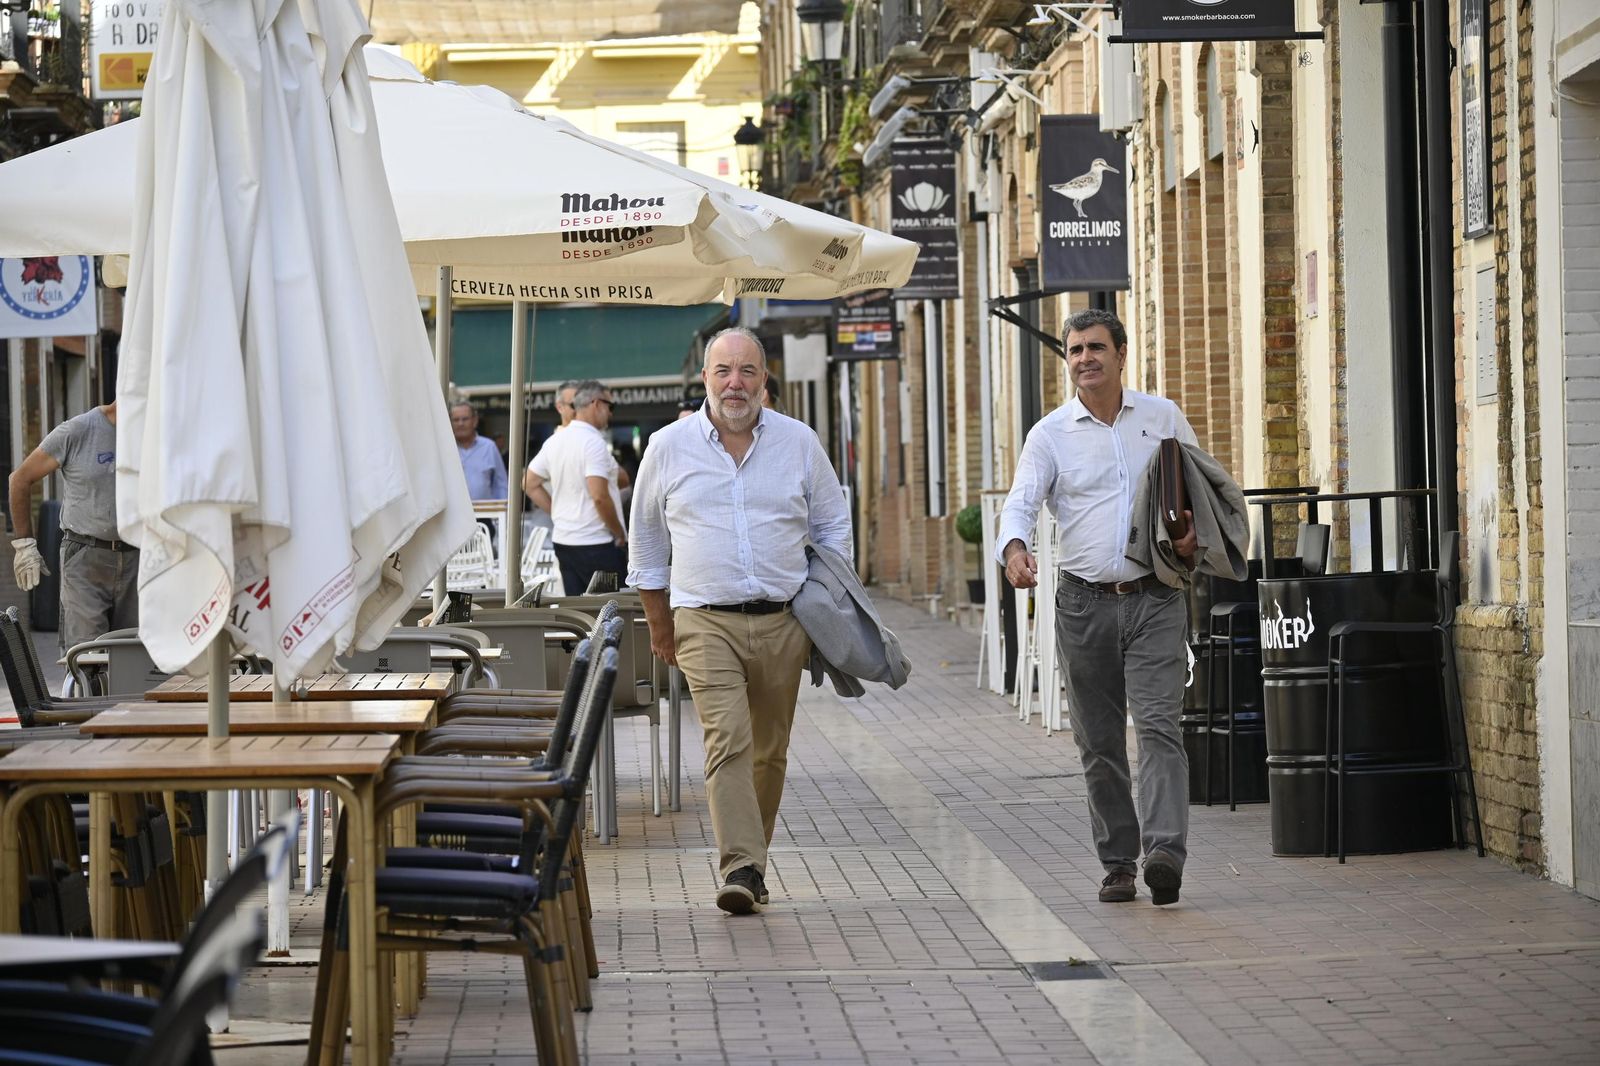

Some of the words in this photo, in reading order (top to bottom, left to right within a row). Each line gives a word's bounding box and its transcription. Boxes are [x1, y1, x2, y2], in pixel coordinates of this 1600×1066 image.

[1162, 13, 1256, 21] www.smokerbarbacoa.com
[560, 193, 664, 213] Mahou
[560, 214, 614, 227] DESDE
[623, 211, 662, 222] 1890
[1049, 221, 1121, 239] CORRELIMOS
[562, 249, 612, 260] DESDE
[620, 236, 653, 251] 1890
[451, 279, 515, 297] CERVEZA
[520, 285, 569, 298] HECHA
[574, 286, 600, 298] SIN
[608, 285, 653, 299] PRISA
